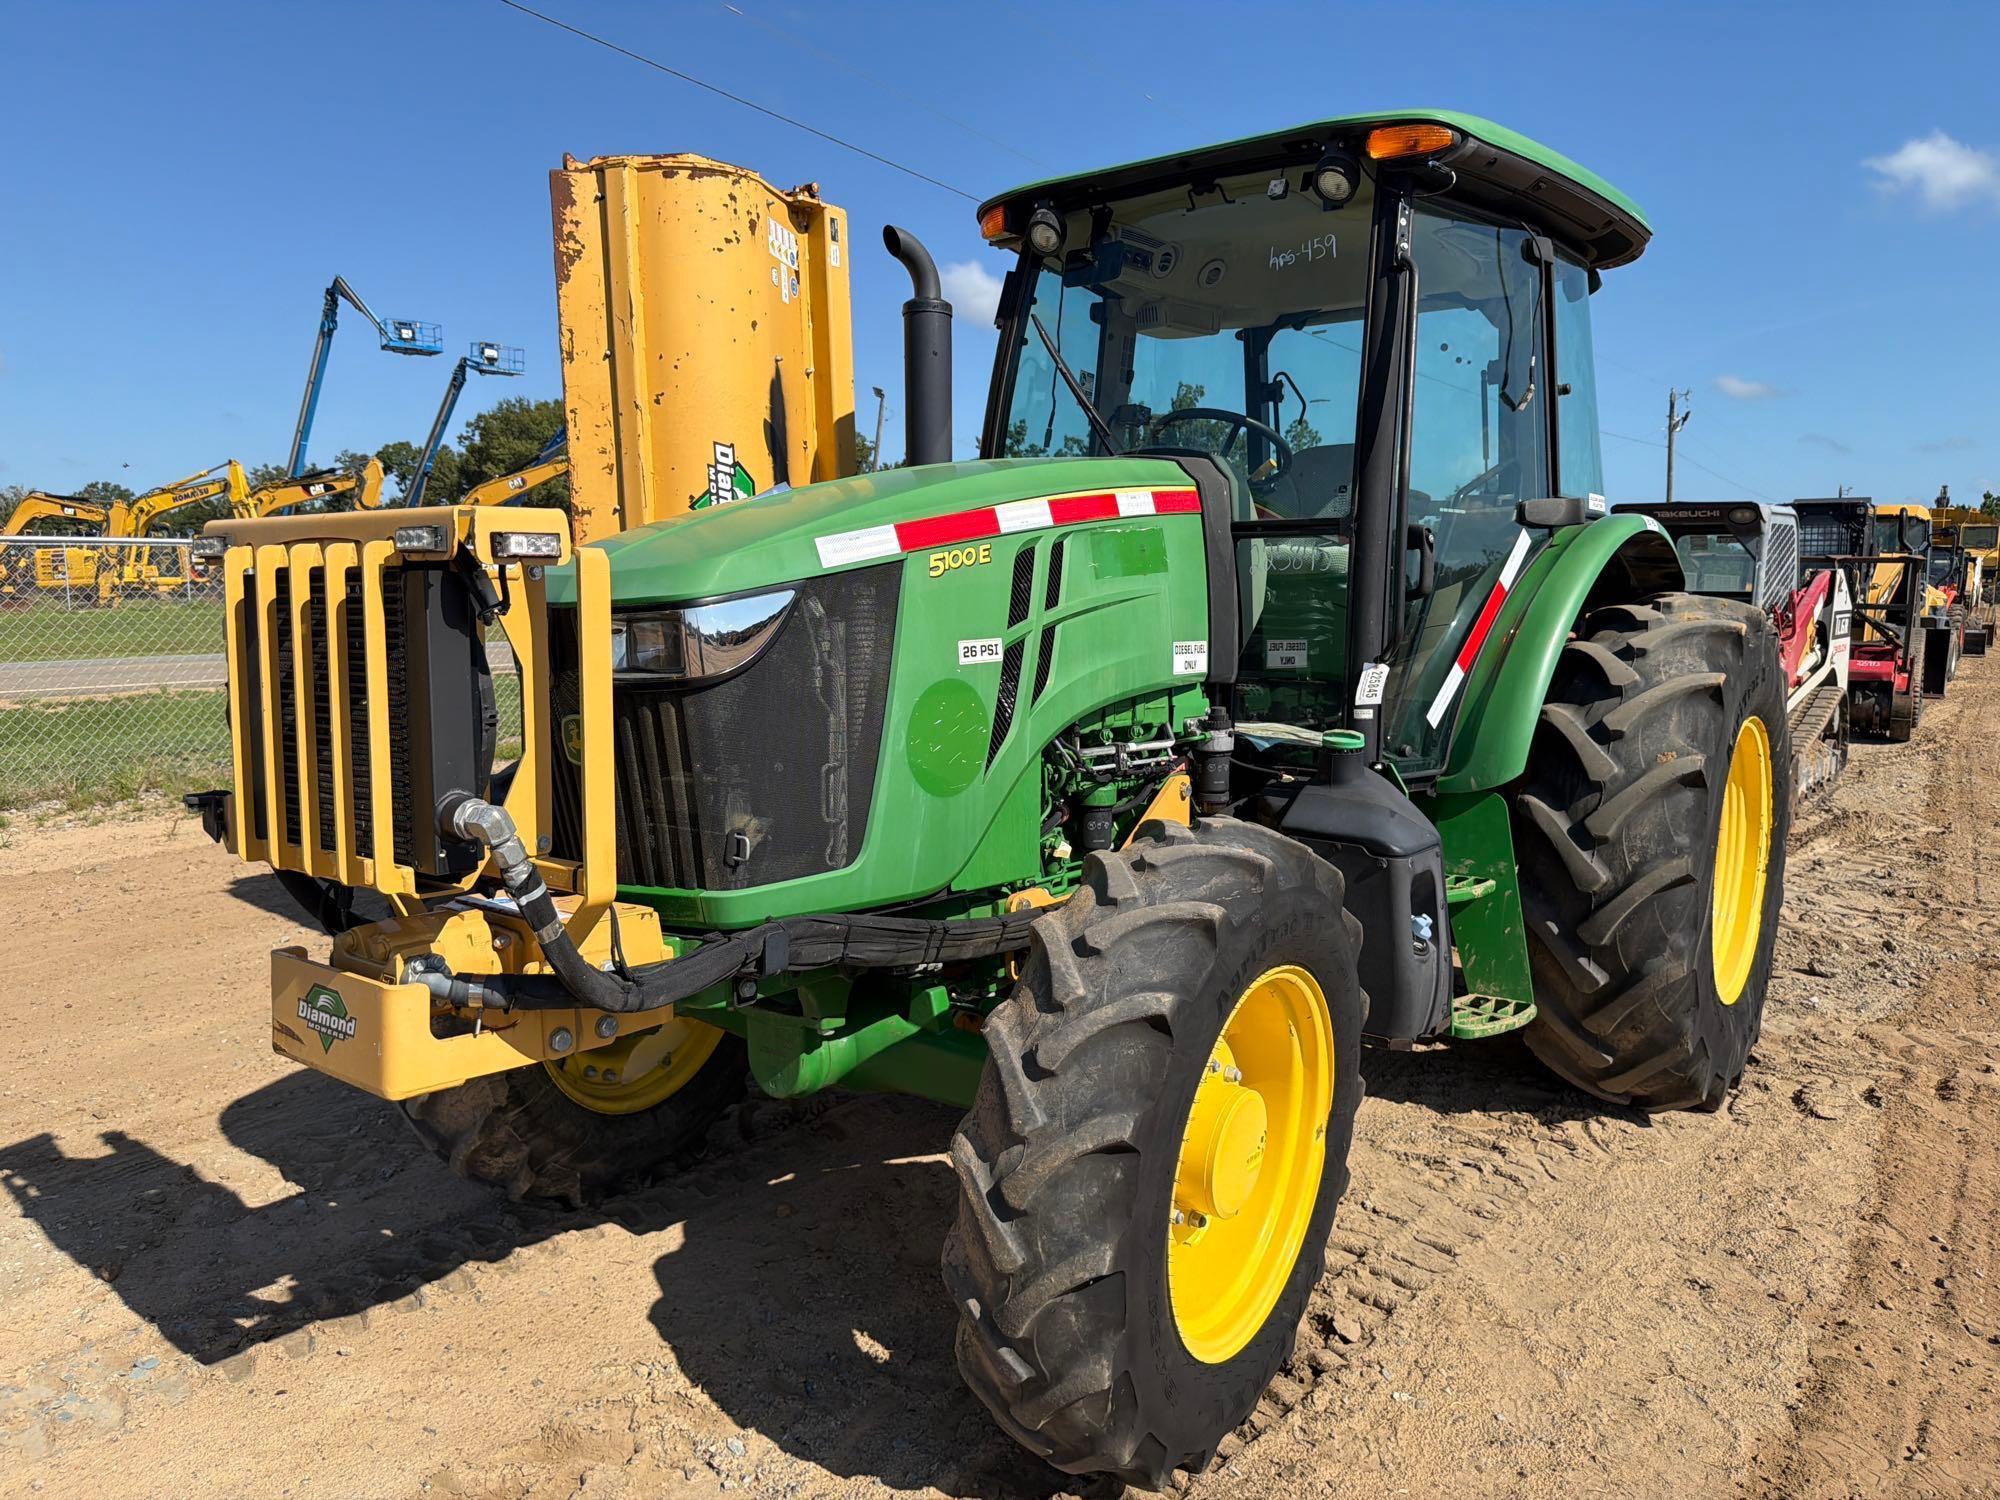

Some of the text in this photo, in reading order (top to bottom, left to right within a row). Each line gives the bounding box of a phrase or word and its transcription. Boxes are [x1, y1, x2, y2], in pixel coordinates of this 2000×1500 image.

[309, 483, 325, 497] CAT
[1653, 510, 1720, 518] TAKEUCHI
[962, 643, 999, 658] 26 PSI
[1174, 644, 1206, 655] DIESEL FUEL
[1184, 660, 1197, 670] ONLY
[1365, 671, 1384, 699] 225845
[298, 1000, 356, 1036] Diamond
[308, 1022, 344, 1040] MOWERS
